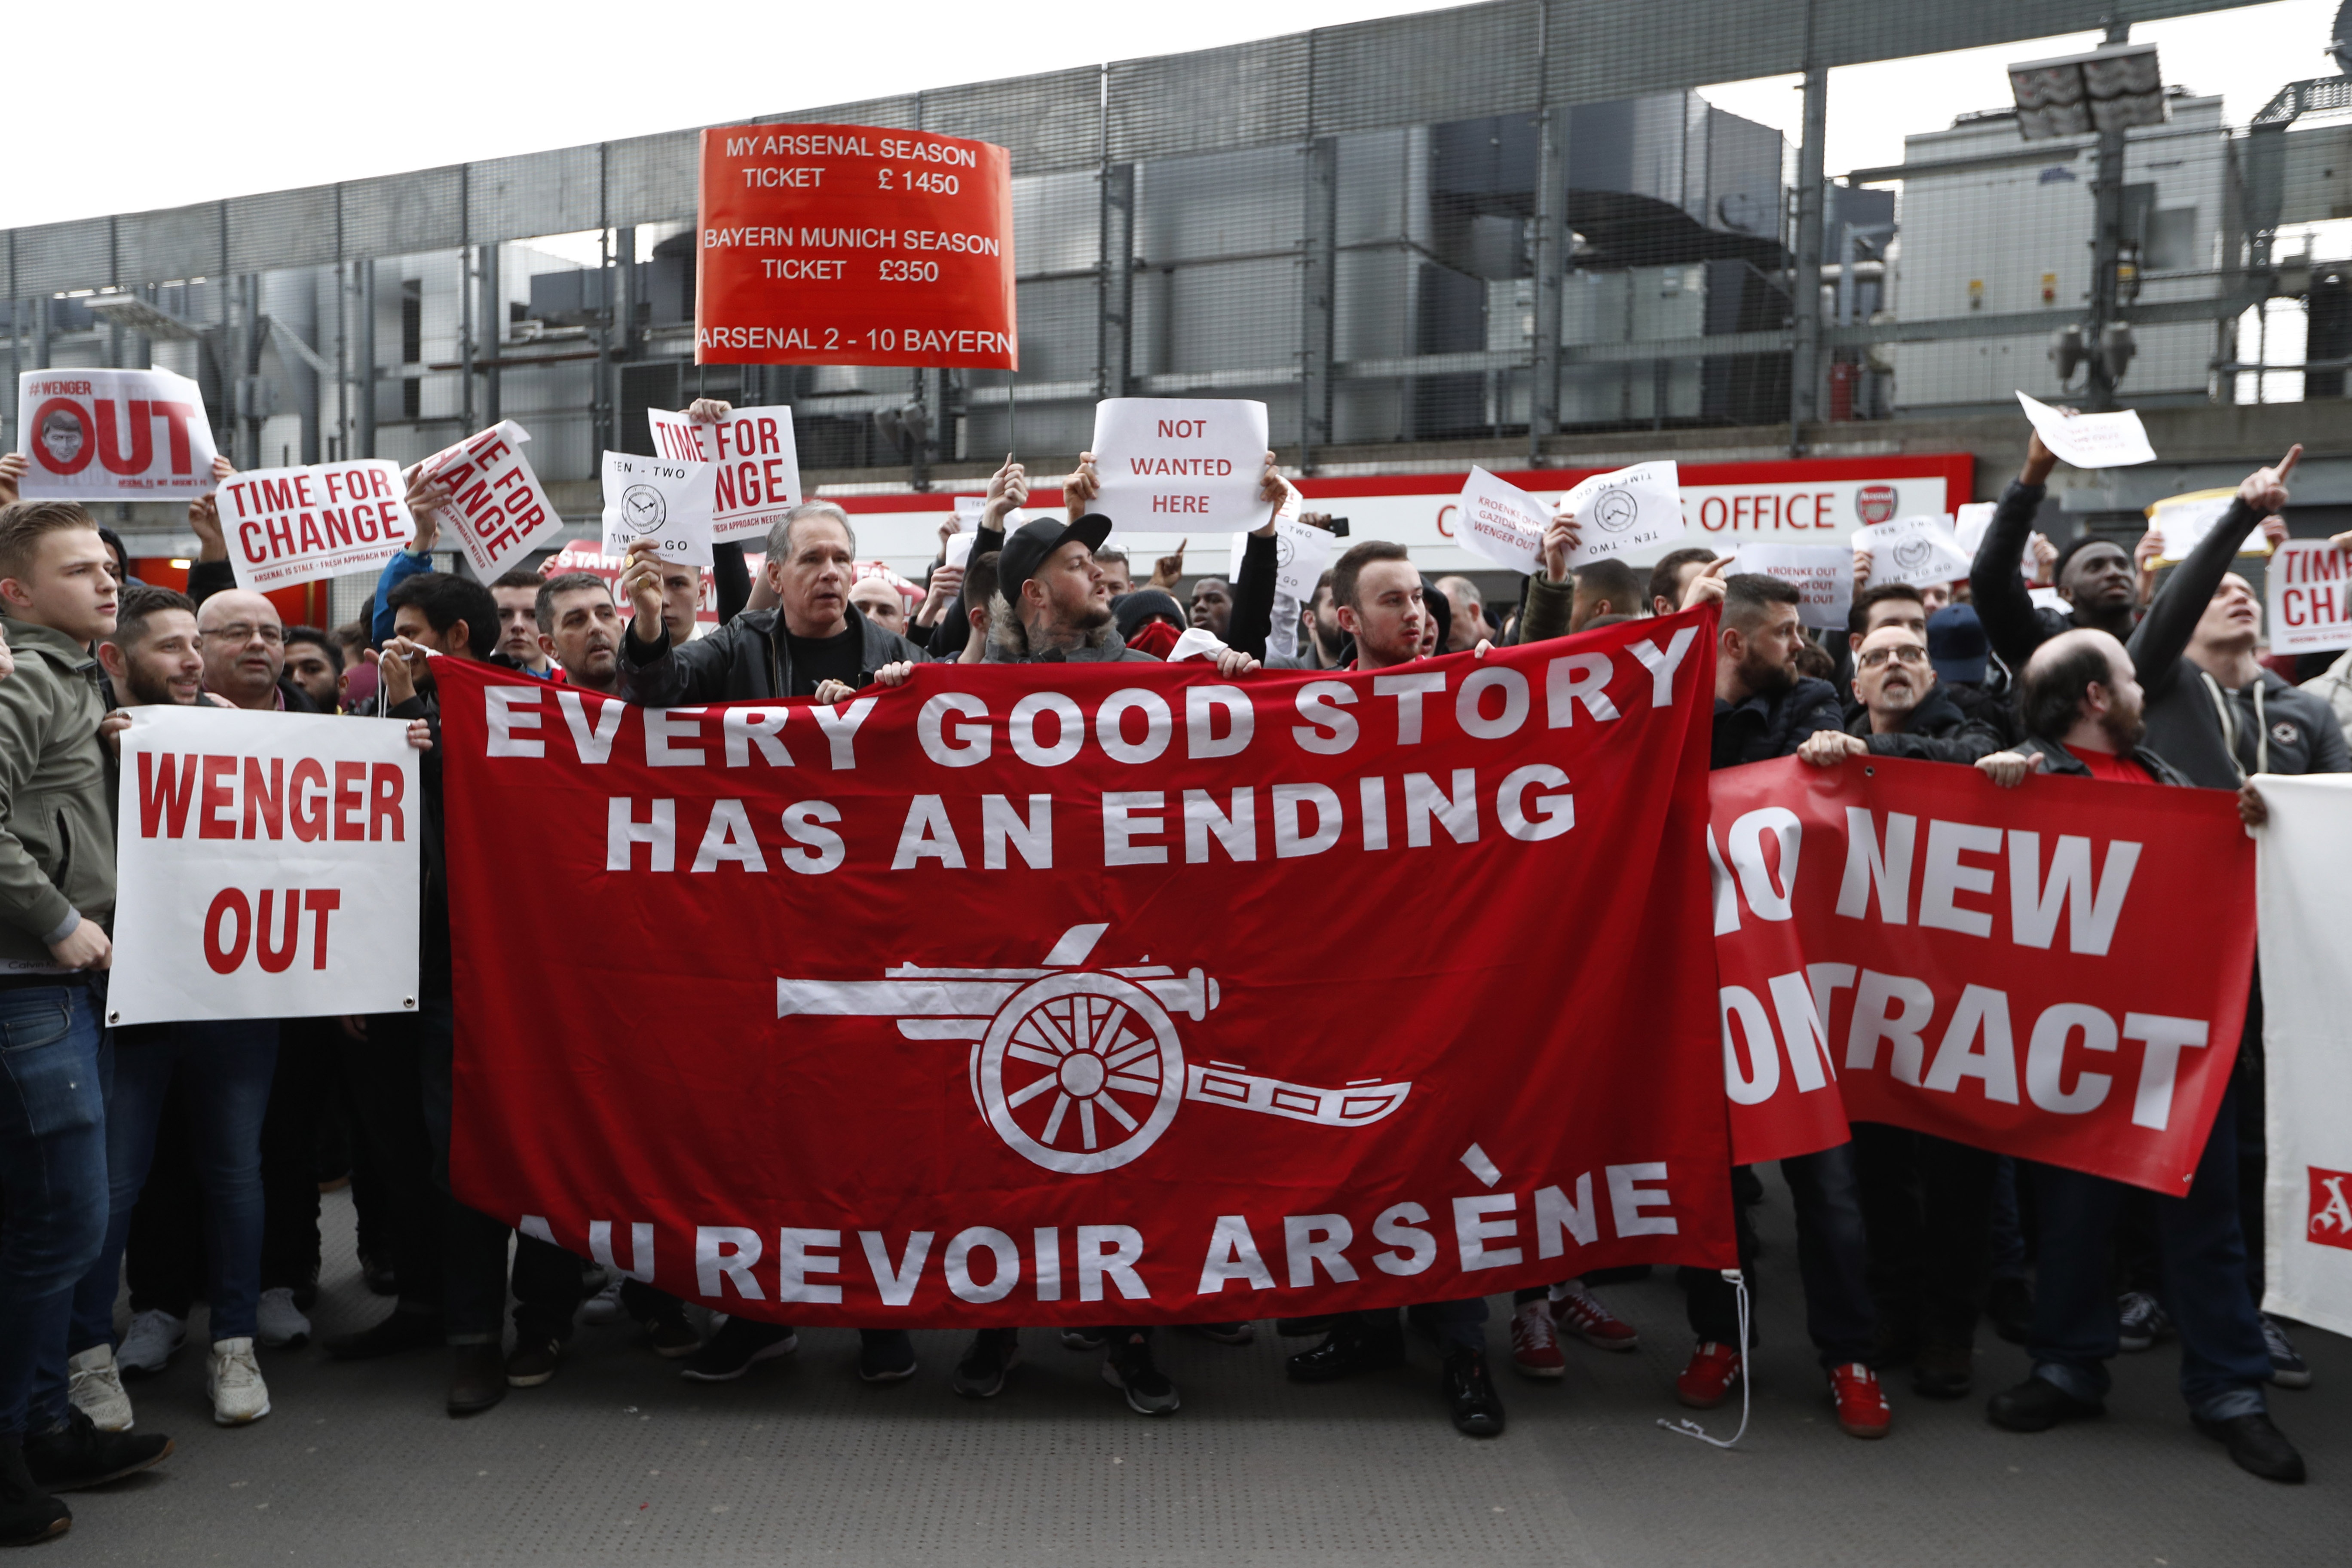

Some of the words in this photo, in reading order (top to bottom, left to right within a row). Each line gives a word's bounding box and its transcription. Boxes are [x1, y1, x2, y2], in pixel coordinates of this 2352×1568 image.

[727, 138, 757, 157] MY
[763, 135, 874, 157] ARSENAL
[879, 139, 976, 168] SEASON
[742, 168, 825, 187] TICKET
[878, 169, 893, 190] £
[902, 171, 960, 195] 1450
[704, 227, 793, 248] BAYERN
[801, 228, 896, 248] MUNICH
[903, 230, 999, 257] SEASON
[761, 259, 847, 279] TICKET
[879, 260, 939, 282] £350
[697, 328, 816, 349] ARSENAL
[824, 328, 839, 349] 2
[867, 329, 896, 351] 10
[903, 329, 1014, 354] BAYERN
[29, 381, 92, 396] #WENGER
[31, 397, 196, 476] OUT
[656, 422, 708, 462] TIME
[715, 418, 780, 460] FOR
[1158, 420, 1206, 438] NOT
[614, 461, 632, 472] TEN
[654, 466, 685, 479] TWO
[1130, 458, 1232, 476] WANTED
[1622, 473, 1652, 485] TIME
[227, 475, 317, 517] TIME
[326, 469, 393, 503] FOR
[713, 459, 787, 513] NGE
[1599, 482, 1614, 491] TO
[493, 466, 545, 537] FOR
[1152, 495, 1210, 513] HERE
[1479, 495, 1521, 519] KROENKE
[1522, 515, 1540, 527] OUT
[1701, 493, 1835, 532] OFFICE
[239, 502, 404, 563] CHANGE
[449, 515, 473, 546] APPROACH
[729, 517, 759, 530] APPROACH
[1289, 525, 1312, 538] TWO
[1474, 520, 1515, 543] WENGER
[1516, 538, 1535, 551] OUT
[1479, 510, 1516, 530] GAZIDIS
[1519, 525, 1538, 537] OUT
[1634, 530, 1658, 543] TEN
[665, 540, 687, 551] GO
[1589, 542, 1618, 554] TWO
[254, 570, 284, 583] ARSENAL
[294, 563, 313, 573] STALE
[321, 559, 342, 569] FRESH
[344, 553, 379, 564] APPROACH
[1283, 576, 1298, 586] GO
[1767, 566, 1813, 576] KROENKE
[1816, 567, 1837, 576] OUT
[1812, 581, 1834, 590] OUT
[1813, 594, 1834, 604] OUT
[484, 685, 879, 770] EVERY
[917, 685, 1254, 768] GOOD
[1292, 625, 1699, 755] STORY
[137, 751, 405, 842] WENGER
[606, 796, 845, 874] HAS
[891, 793, 1053, 870] AN
[1102, 763, 1575, 866] ENDING
[1835, 806, 2144, 956] NEW
[203, 886, 340, 975] OUT
[1721, 962, 2210, 1132] ONTRACT
[695, 1224, 1152, 1307] REVOIR
[1197, 1142, 1678, 1295] ARSÈNE
